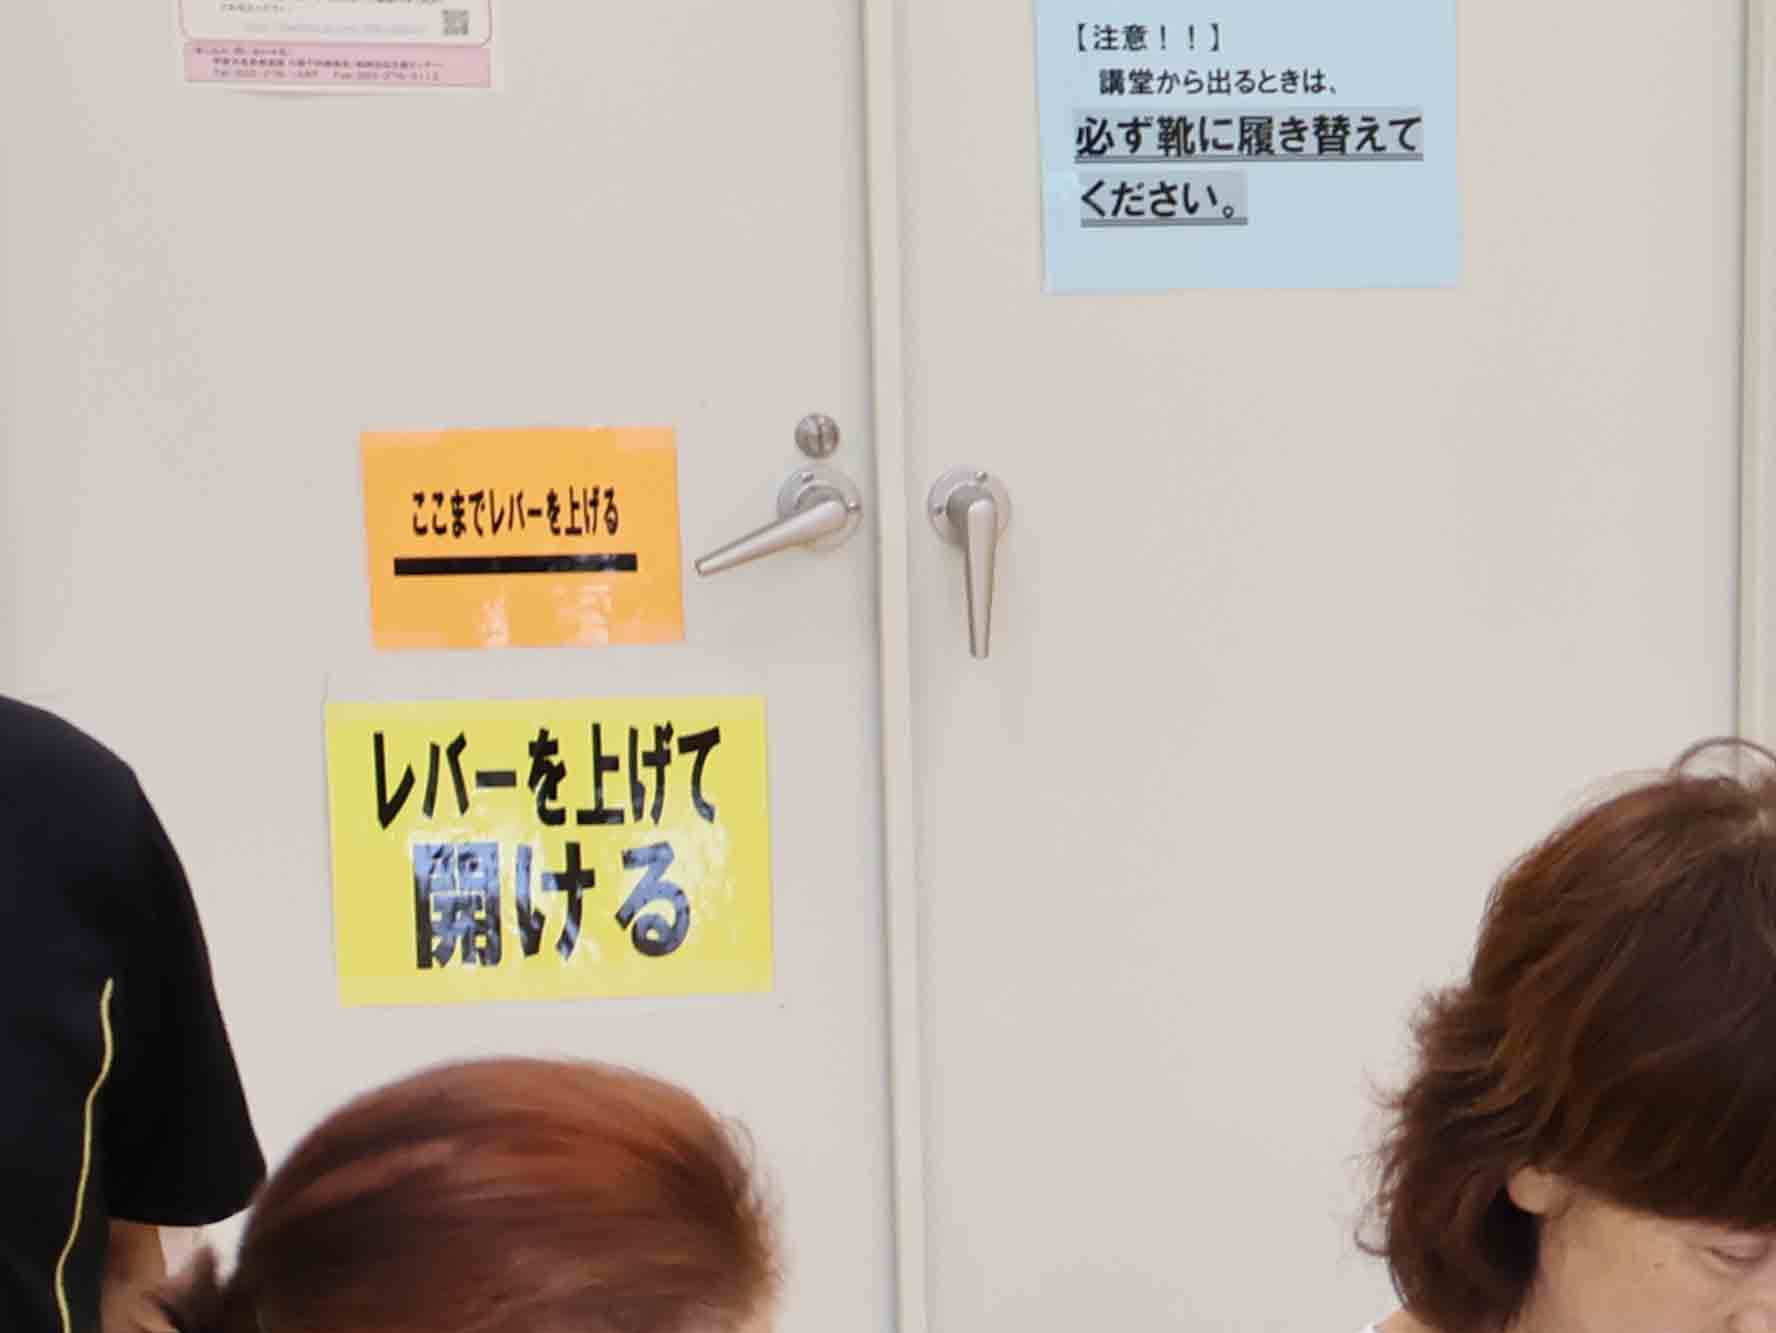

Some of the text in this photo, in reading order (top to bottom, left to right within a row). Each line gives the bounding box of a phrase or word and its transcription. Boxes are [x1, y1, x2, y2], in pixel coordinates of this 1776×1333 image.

[1076, 22, 1222, 53] 【注意！！】
[1098, 68, 1337, 97] 講堂から出るときは、
[1075, 114, 1424, 156] 必ず靴に履き替えて
[1080, 180, 1236, 219] ください。
[411, 485, 620, 540] ここまでレバーを上げる
[373, 719, 722, 832] レバーを上げて
[412, 840, 691, 971] 開ける
